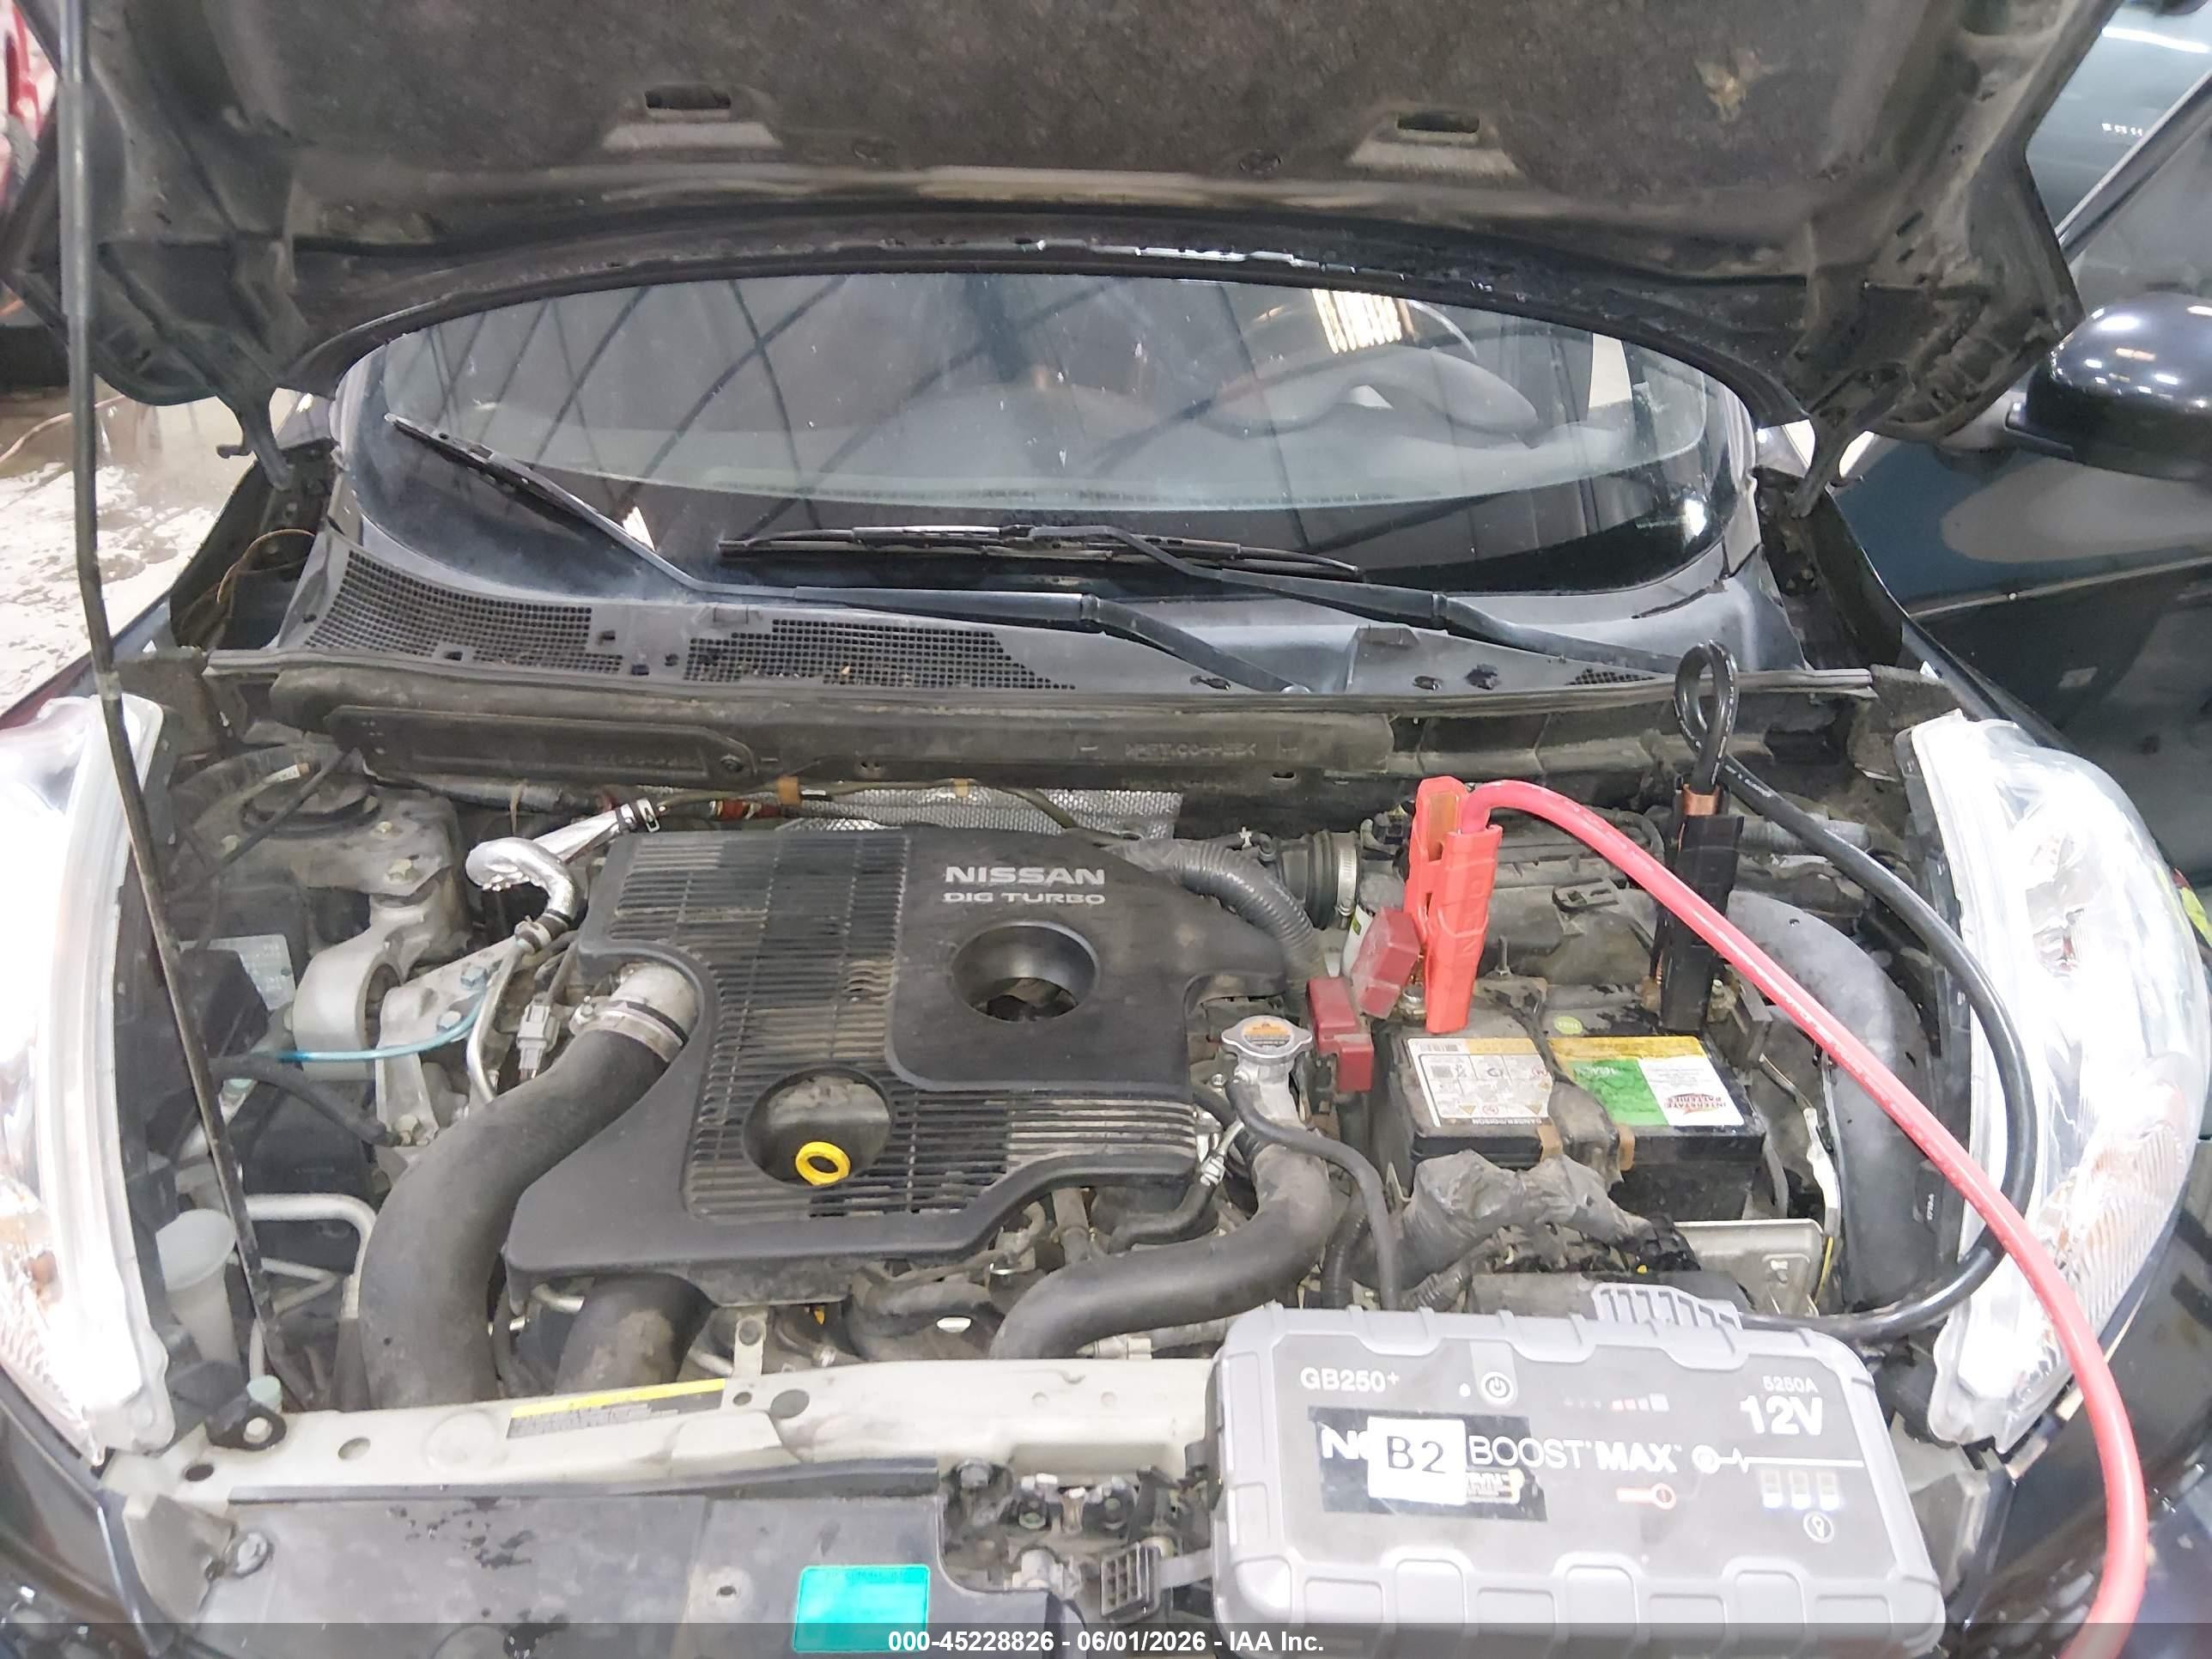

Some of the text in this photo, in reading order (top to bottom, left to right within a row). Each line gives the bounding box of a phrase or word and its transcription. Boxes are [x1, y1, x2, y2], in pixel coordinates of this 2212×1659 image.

[945, 866, 1105, 884] NISSAN
[944, 891, 1106, 904] DIG TURBO
[1300, 1367, 1400, 1393] GB250+
[1740, 1395, 1823, 1436] 12V
[1468, 1435, 1678, 1474] BOOST MAX
